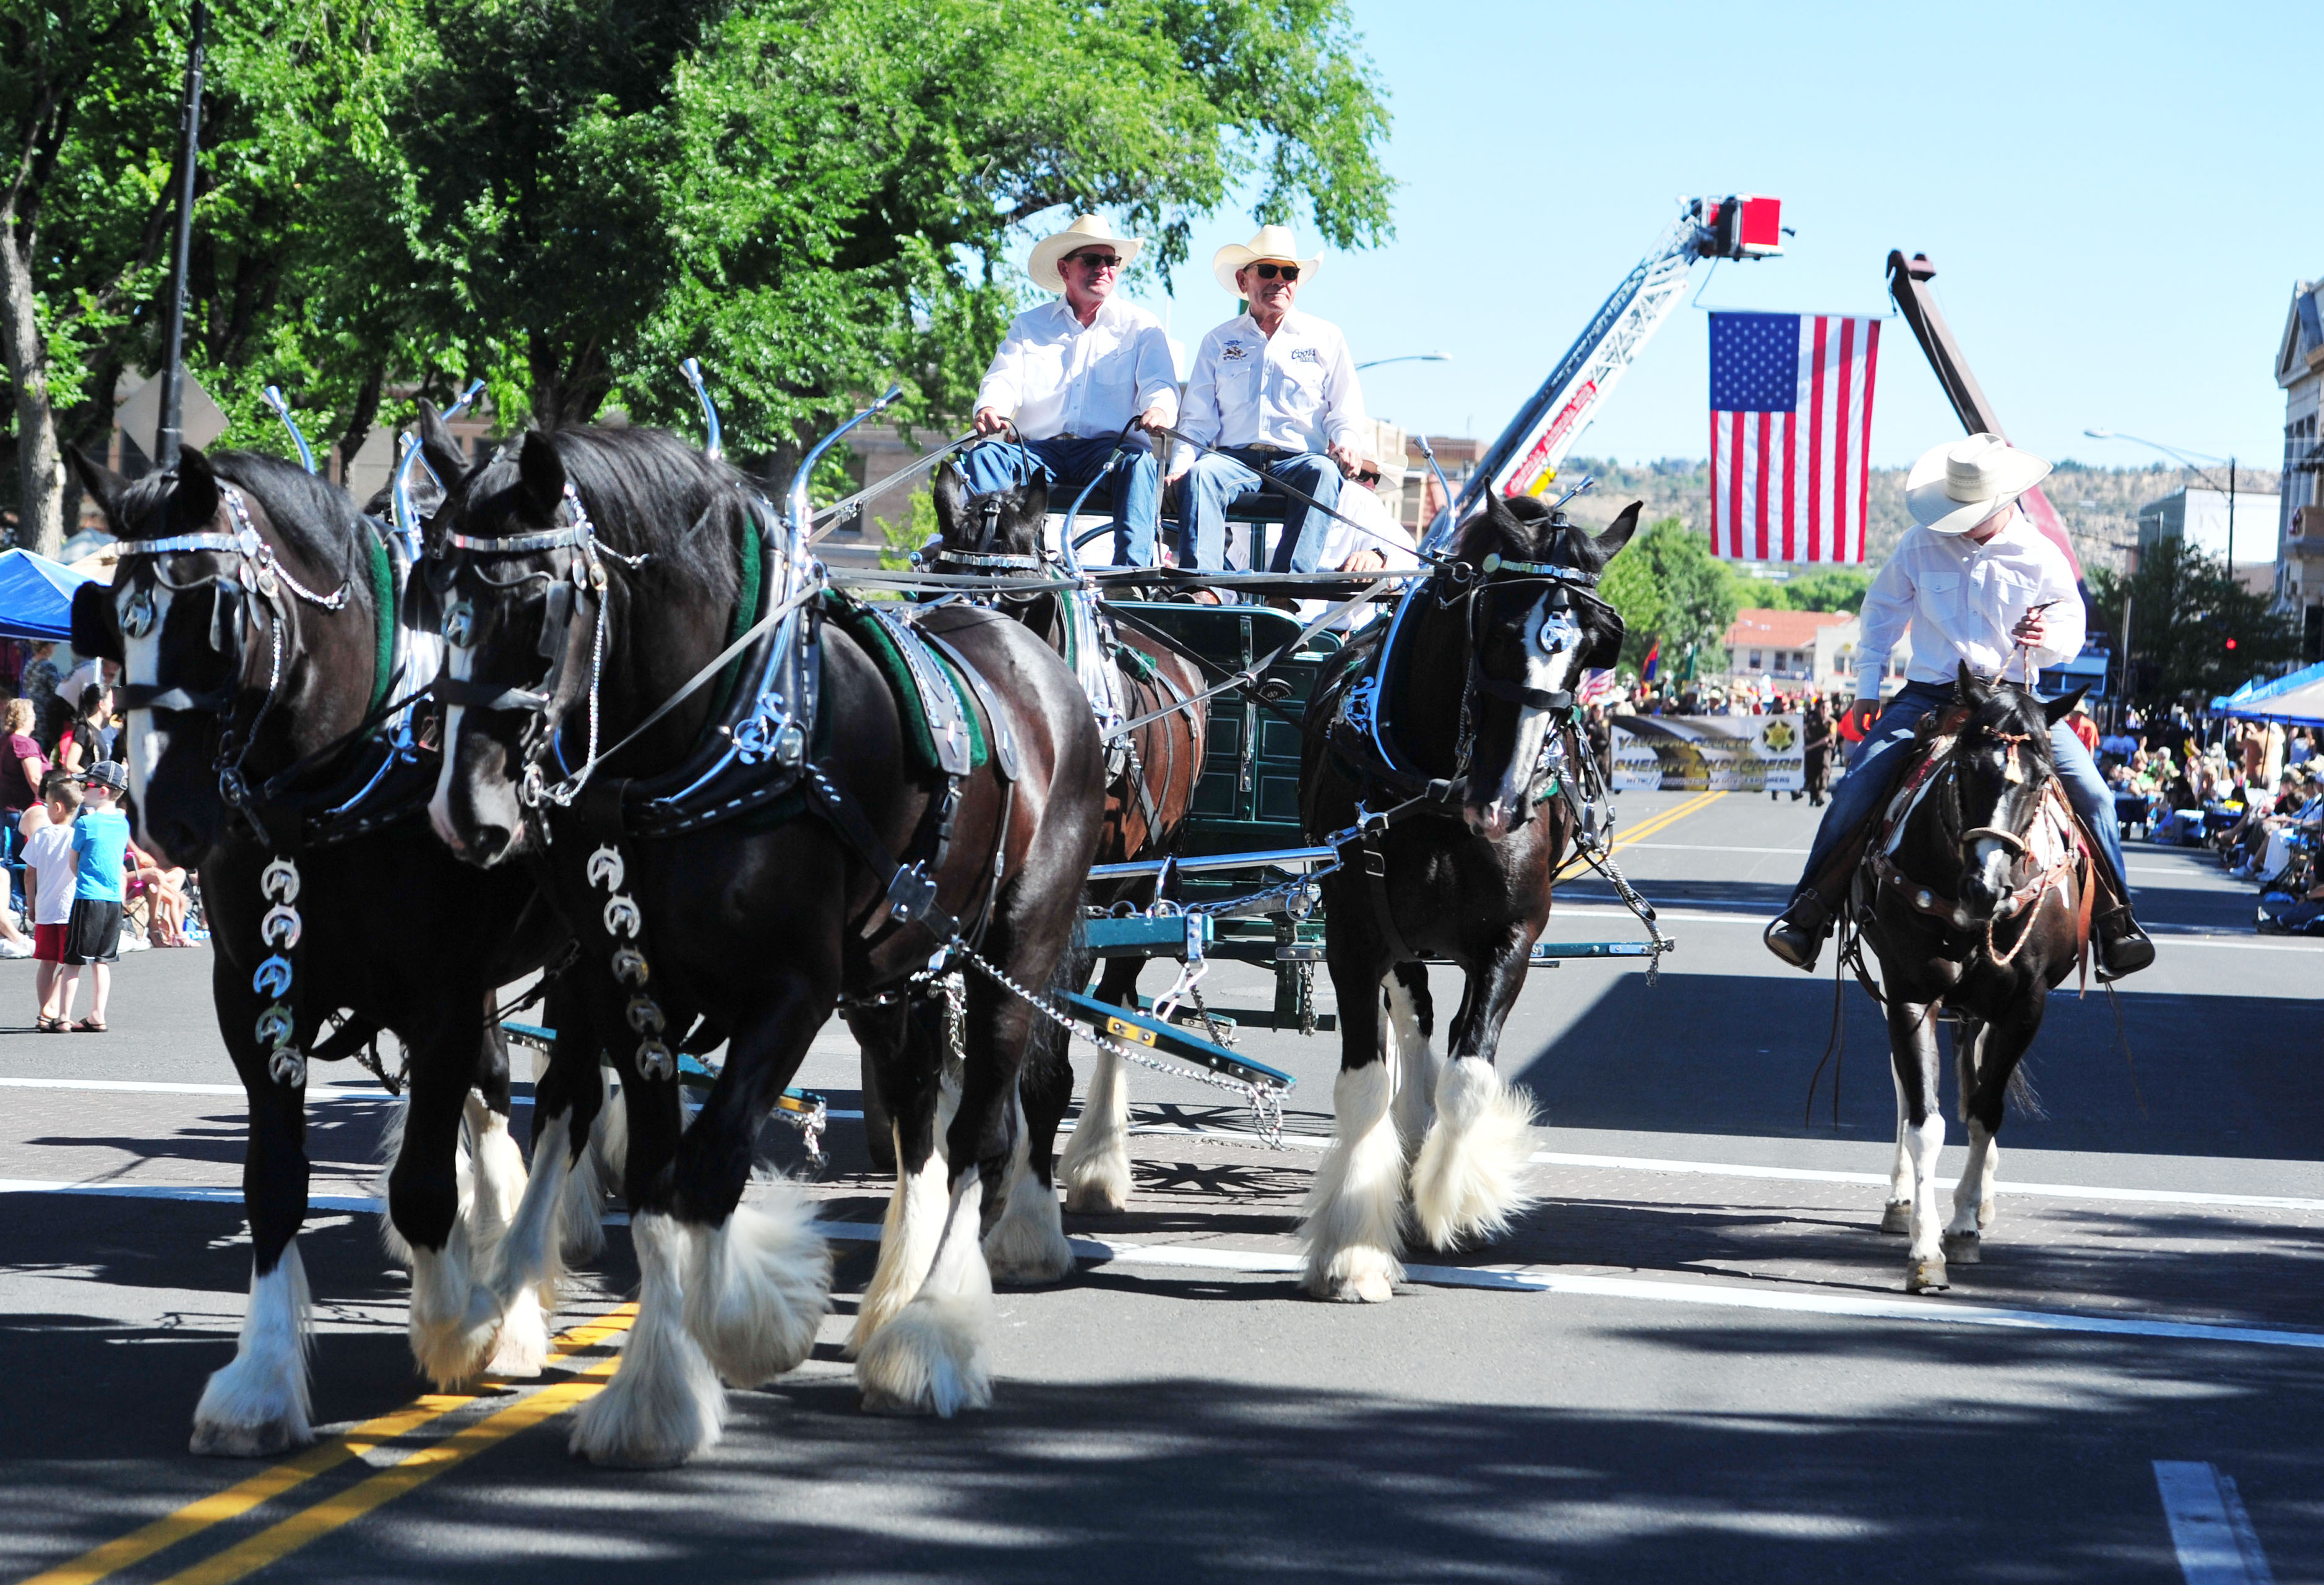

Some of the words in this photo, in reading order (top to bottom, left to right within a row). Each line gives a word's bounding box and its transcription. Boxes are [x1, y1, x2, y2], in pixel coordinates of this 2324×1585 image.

[1617, 736, 1688, 750] YAVAPAI
[1689, 736, 1755, 750] COUNTY
[1614, 758, 1690, 772] SHERIFF
[1694, 758, 1802, 771] EXPLORERS
